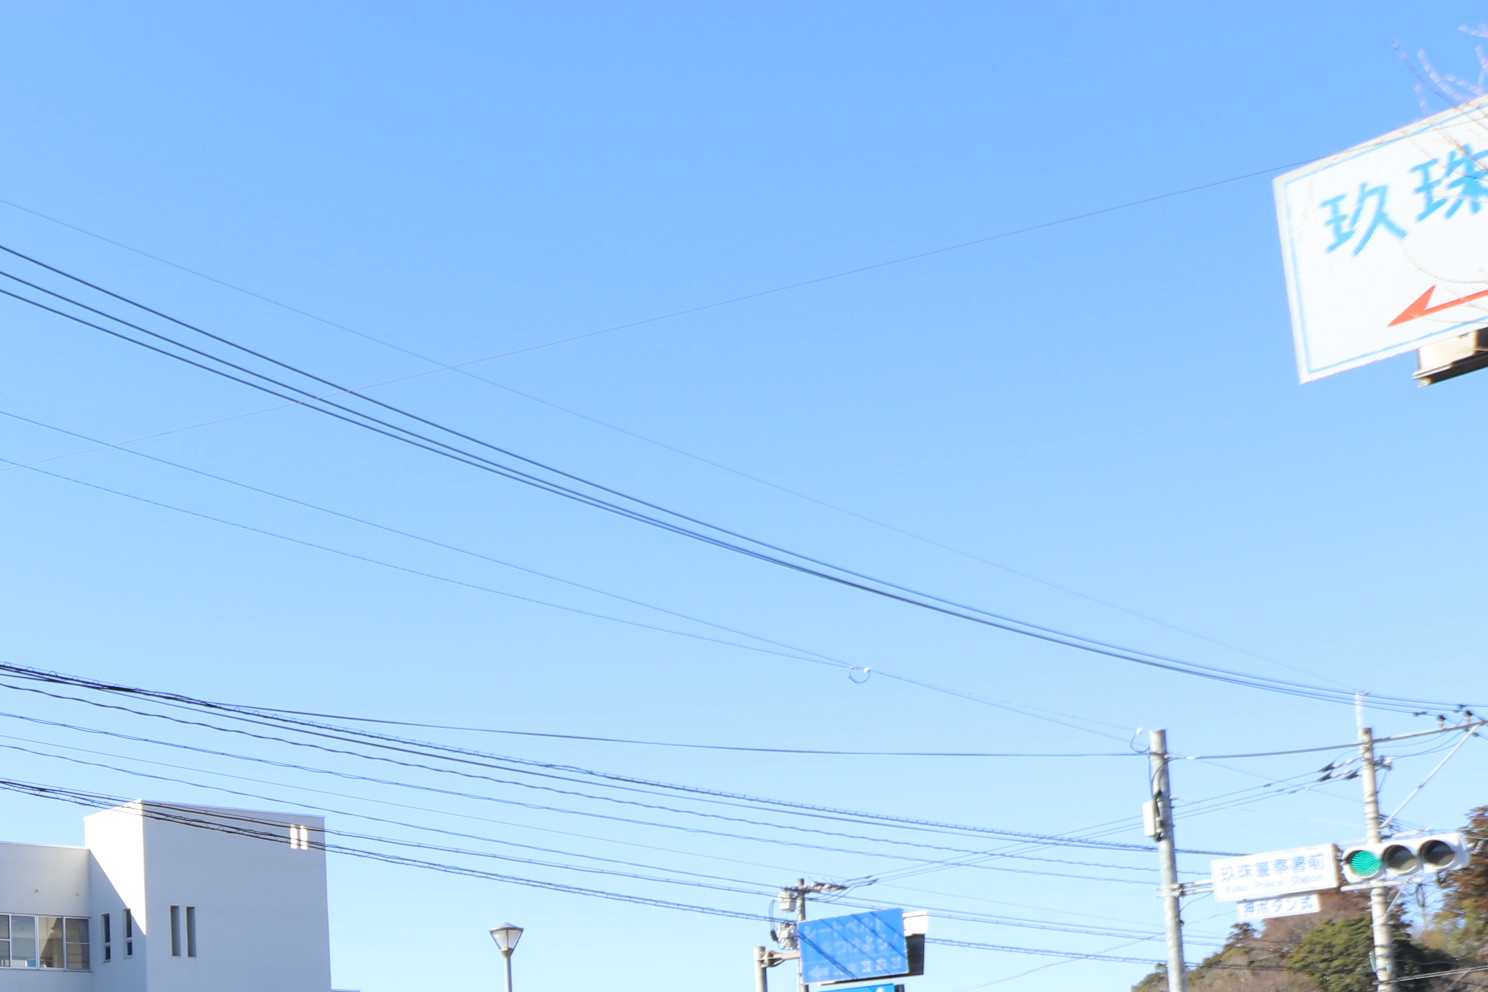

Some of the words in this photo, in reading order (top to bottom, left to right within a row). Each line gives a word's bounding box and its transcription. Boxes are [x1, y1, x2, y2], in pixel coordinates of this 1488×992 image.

[1318, 143, 1488, 258] 玖珠
[1220, 853, 1325, 882] 玖珠警察署前
[1225, 884, 1248, 893] Kusu
[1254, 880, 1283, 889] Police
[1290, 874, 1324, 885] Station
